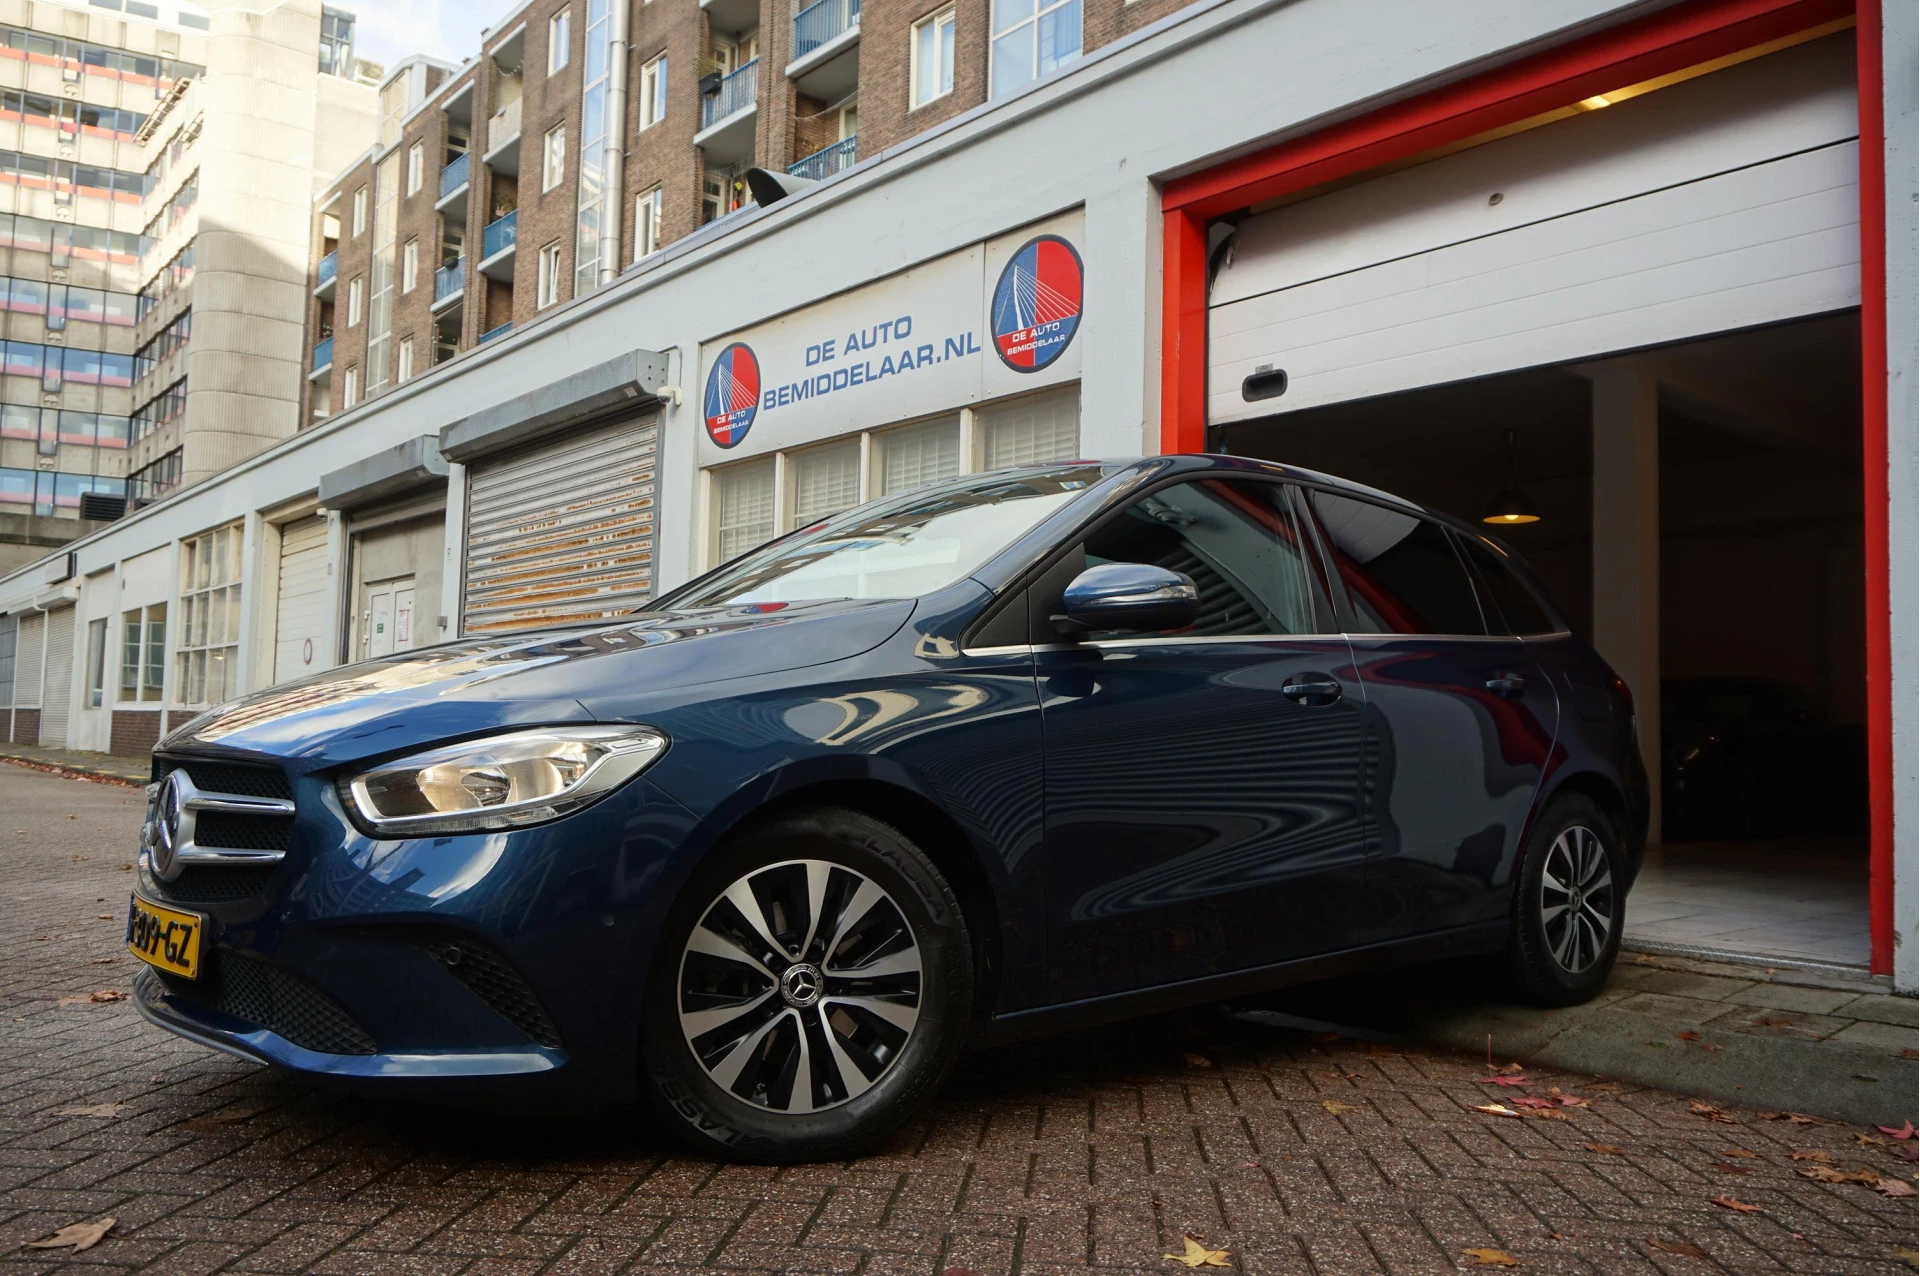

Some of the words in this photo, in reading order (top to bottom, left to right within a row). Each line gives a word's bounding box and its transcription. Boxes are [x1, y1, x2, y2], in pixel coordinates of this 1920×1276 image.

[806, 339, 835, 367] DE
[843, 315, 912, 356] AUTO
[1012, 331, 1027, 343] DE
[1029, 322, 1060, 338] AUTO
[1007, 334, 1065, 356] BEMIDDELAAR
[763, 331, 981, 411] BEMIDDELAAR.NL
[716, 415, 727, 424] DE
[727, 410, 746, 421] AUTO
